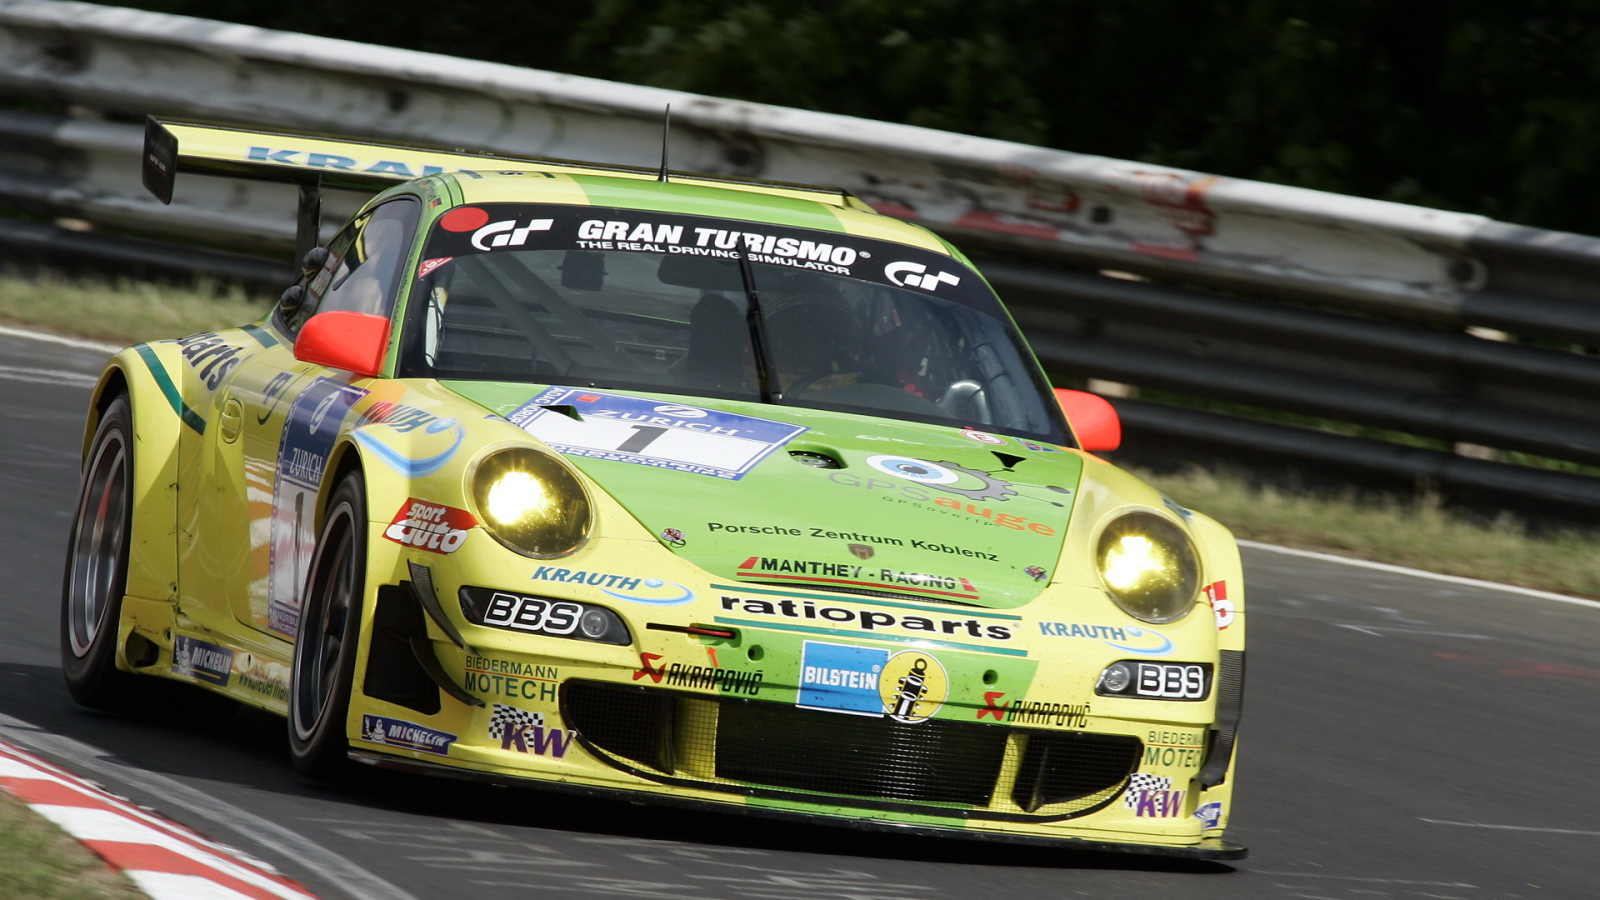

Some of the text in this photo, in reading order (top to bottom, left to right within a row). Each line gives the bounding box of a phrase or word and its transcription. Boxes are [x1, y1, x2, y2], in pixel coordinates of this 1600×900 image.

[578, 219, 682, 245] GRAN
[576, 240, 851, 276] THE REAL DRIVING SIMULATOR
[174, 331, 240, 391] parts
[599, 409, 740, 437] ZURICH
[615, 424, 670, 453] 1
[289, 446, 323, 483] ZURICH
[406, 502, 447, 523] sport
[293, 491, 304, 604] 1
[386, 518, 468, 553] auto
[708, 522, 1000, 562] Porsche Zentrum Koblenz
[532, 565, 642, 591] KRAUTH
[761, 556, 863, 580] MANTHEY
[881, 568, 957, 590] RACING
[484, 592, 583, 634] BBS
[720, 595, 1013, 641] ratioparts
[1038, 621, 1127, 641] KRAUTH
[191, 646, 232, 675] MICHELIN
[465, 655, 558, 680] BIEDERMANN
[464, 671, 557, 703] MOTECH
[804, 665, 878, 691] BILSTEIN
[1137, 663, 1204, 698] BBS
[388, 724, 451, 748] MICHELIN
[501, 722, 576, 759] KW
[1136, 789, 1187, 818] KW
